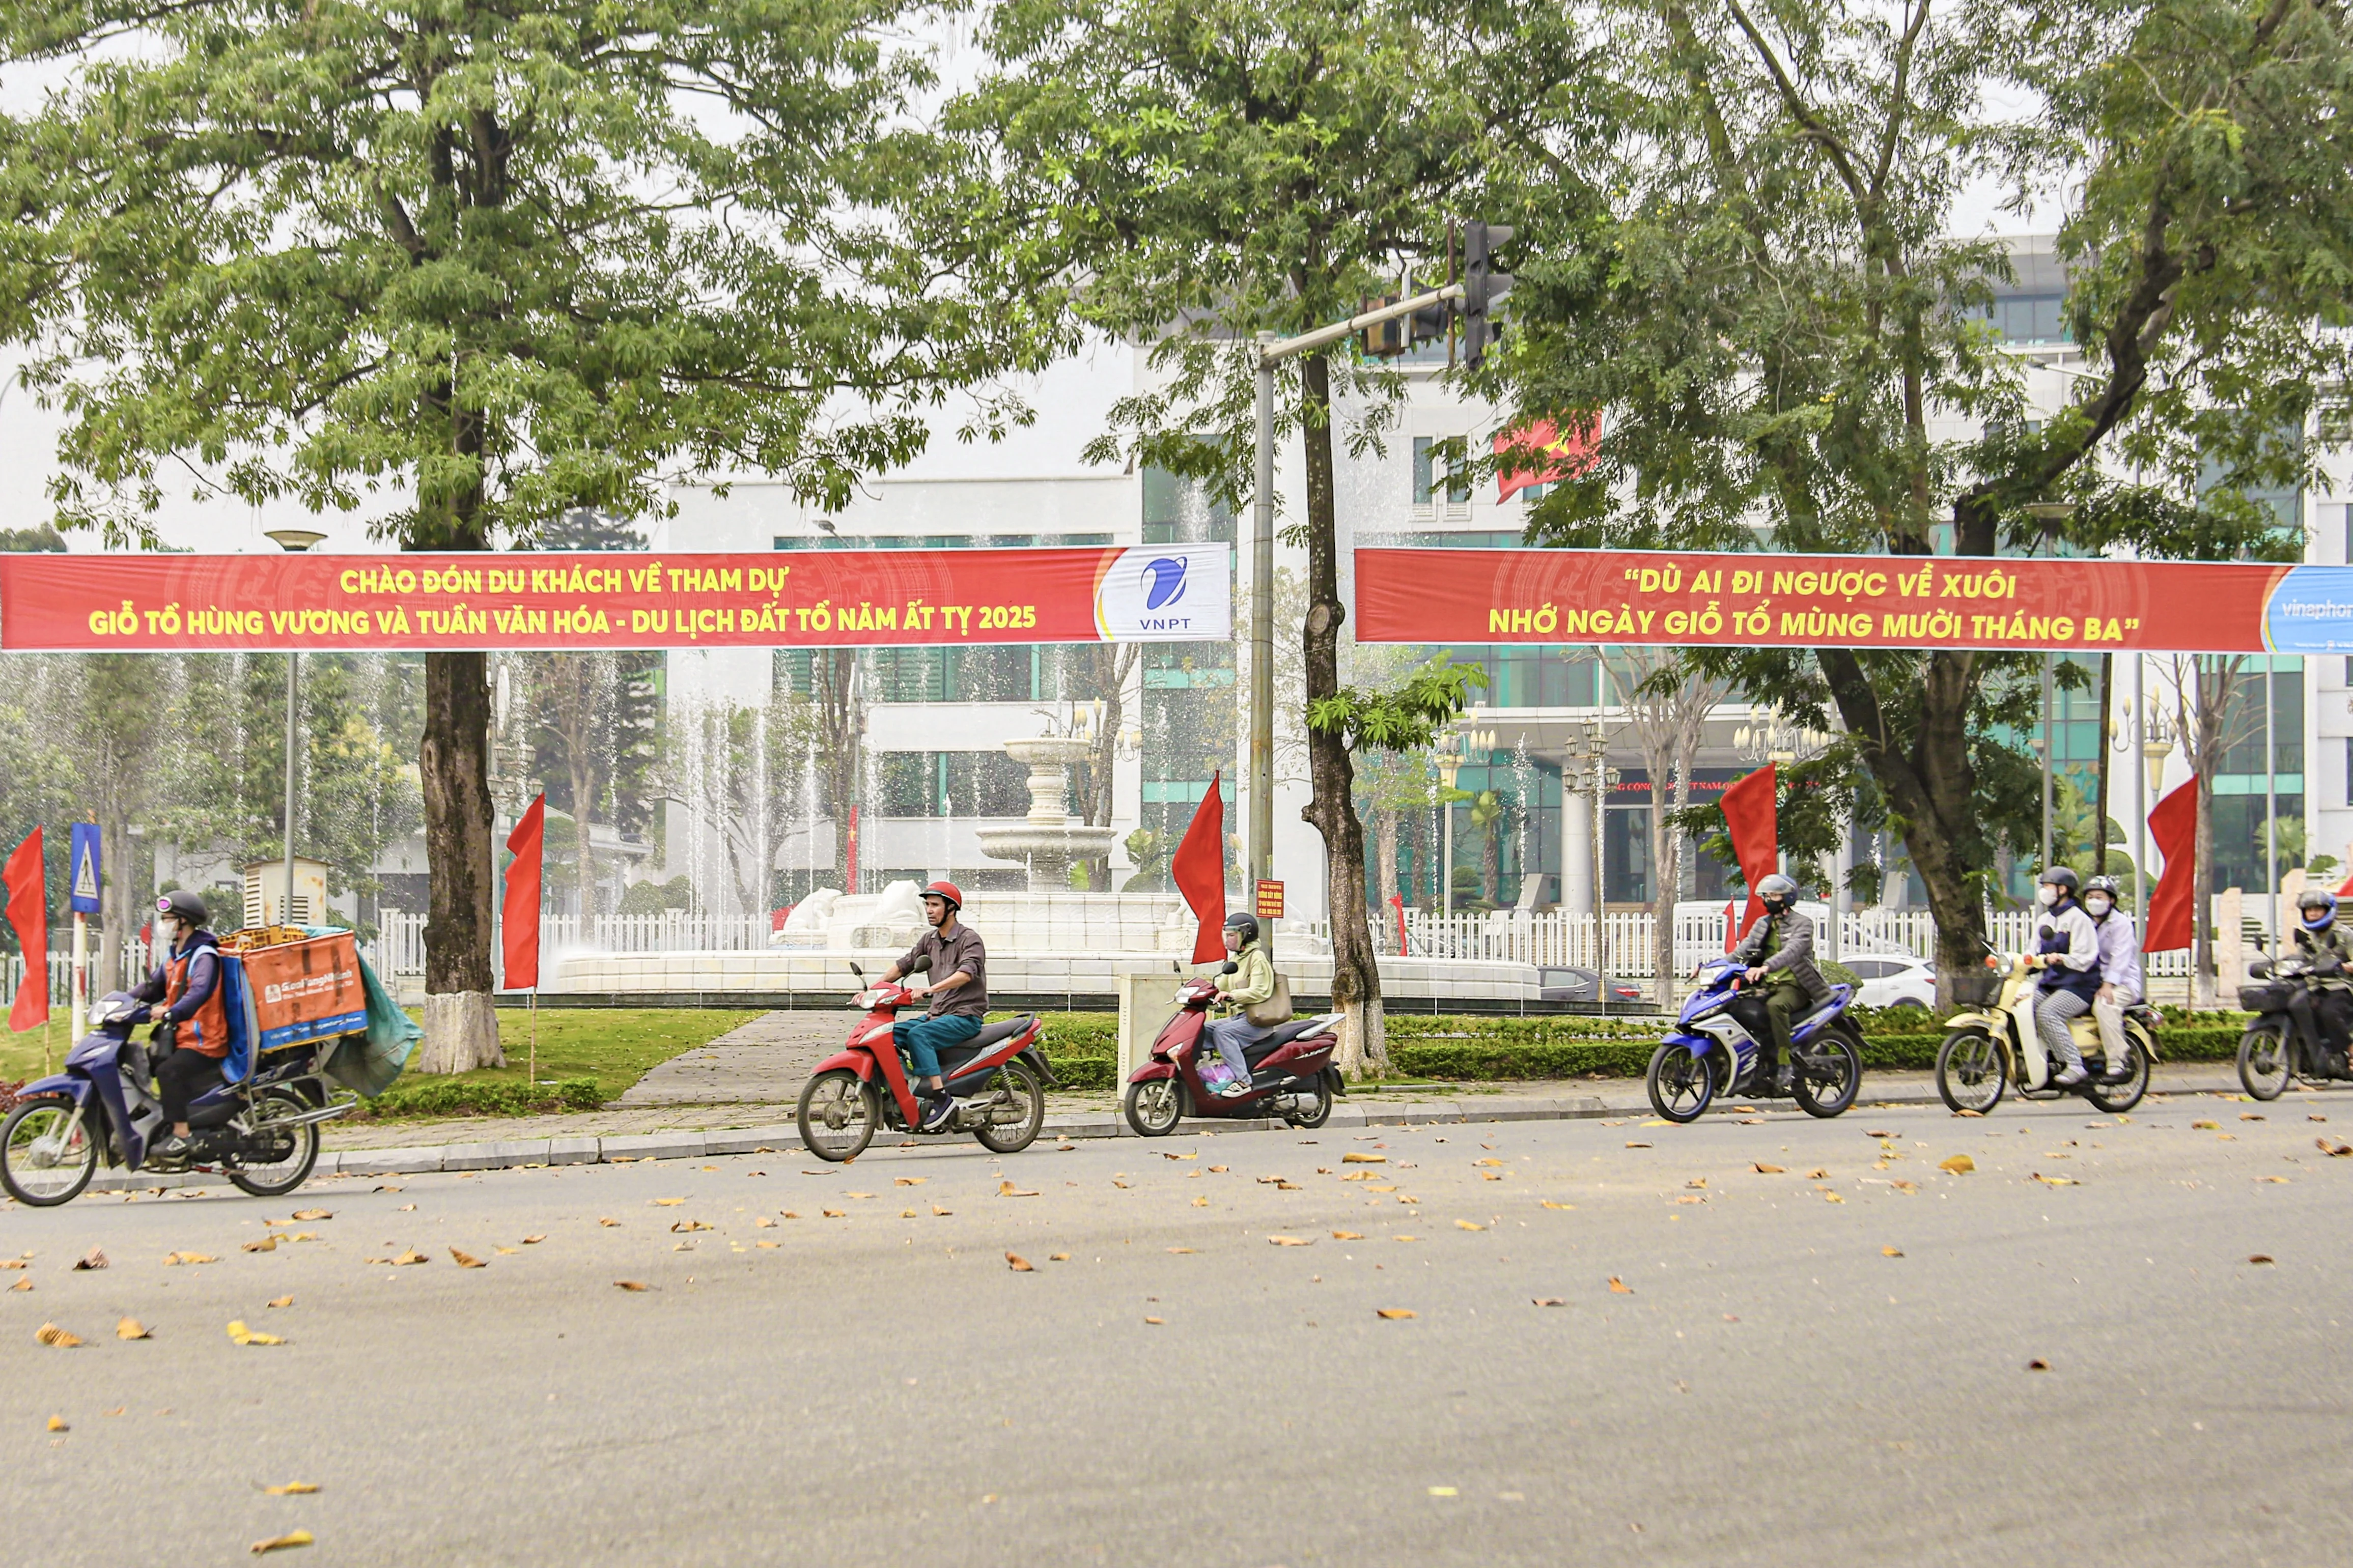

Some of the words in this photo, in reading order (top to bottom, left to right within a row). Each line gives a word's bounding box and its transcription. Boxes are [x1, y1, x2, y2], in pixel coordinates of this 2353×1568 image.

[341, 565, 417, 593] CHÀO
[423, 565, 482, 593] ĐÓN
[489, 569, 525, 593] DU
[532, 564, 622, 593] KHÁCH
[628, 561, 662, 592] VỀ
[668, 568, 742, 592] THAM
[749, 566, 790, 598] DỰ
[1690, 570, 1722, 593] AI
[1732, 571, 1763, 594] ĐI
[1772, 568, 1888, 602] NGƯỢC
[1898, 562, 1934, 597] VỀ
[1941, 569, 2016, 598] XUÔI
[89, 601, 139, 635] GIỖ
[145, 602, 181, 635] TỔ
[188, 605, 264, 635] HÙNG
[270, 609, 370, 635] VƯƠNG
[376, 605, 411, 634] VÀ
[417, 603, 487, 634] TUẦN
[494, 605, 547, 634] VĂN
[553, 605, 610, 634] HÓA
[632, 610, 668, 633] DU
[676, 609, 735, 639] LỊCH
[740, 601, 790, 632] ĐẤT
[796, 600, 831, 632] TỔ
[838, 602, 897, 630] NĂM
[903, 599, 935, 630] ẤT
[940, 606, 973, 636] TỴ
[979, 606, 1037, 629] 2025
[1139, 618, 1191, 630] VNPT
[1489, 602, 1558, 633] NHỚ
[1567, 603, 1655, 634] NGÀY
[1664, 601, 1723, 635] GIỖ
[1732, 600, 1771, 635] TỔ
[1780, 606, 1873, 637] MÙNG
[1883, 609, 1962, 638] MƯỜI
[1971, 609, 2075, 641] THÁNG
[1699, 782, 1721, 790] NAM
